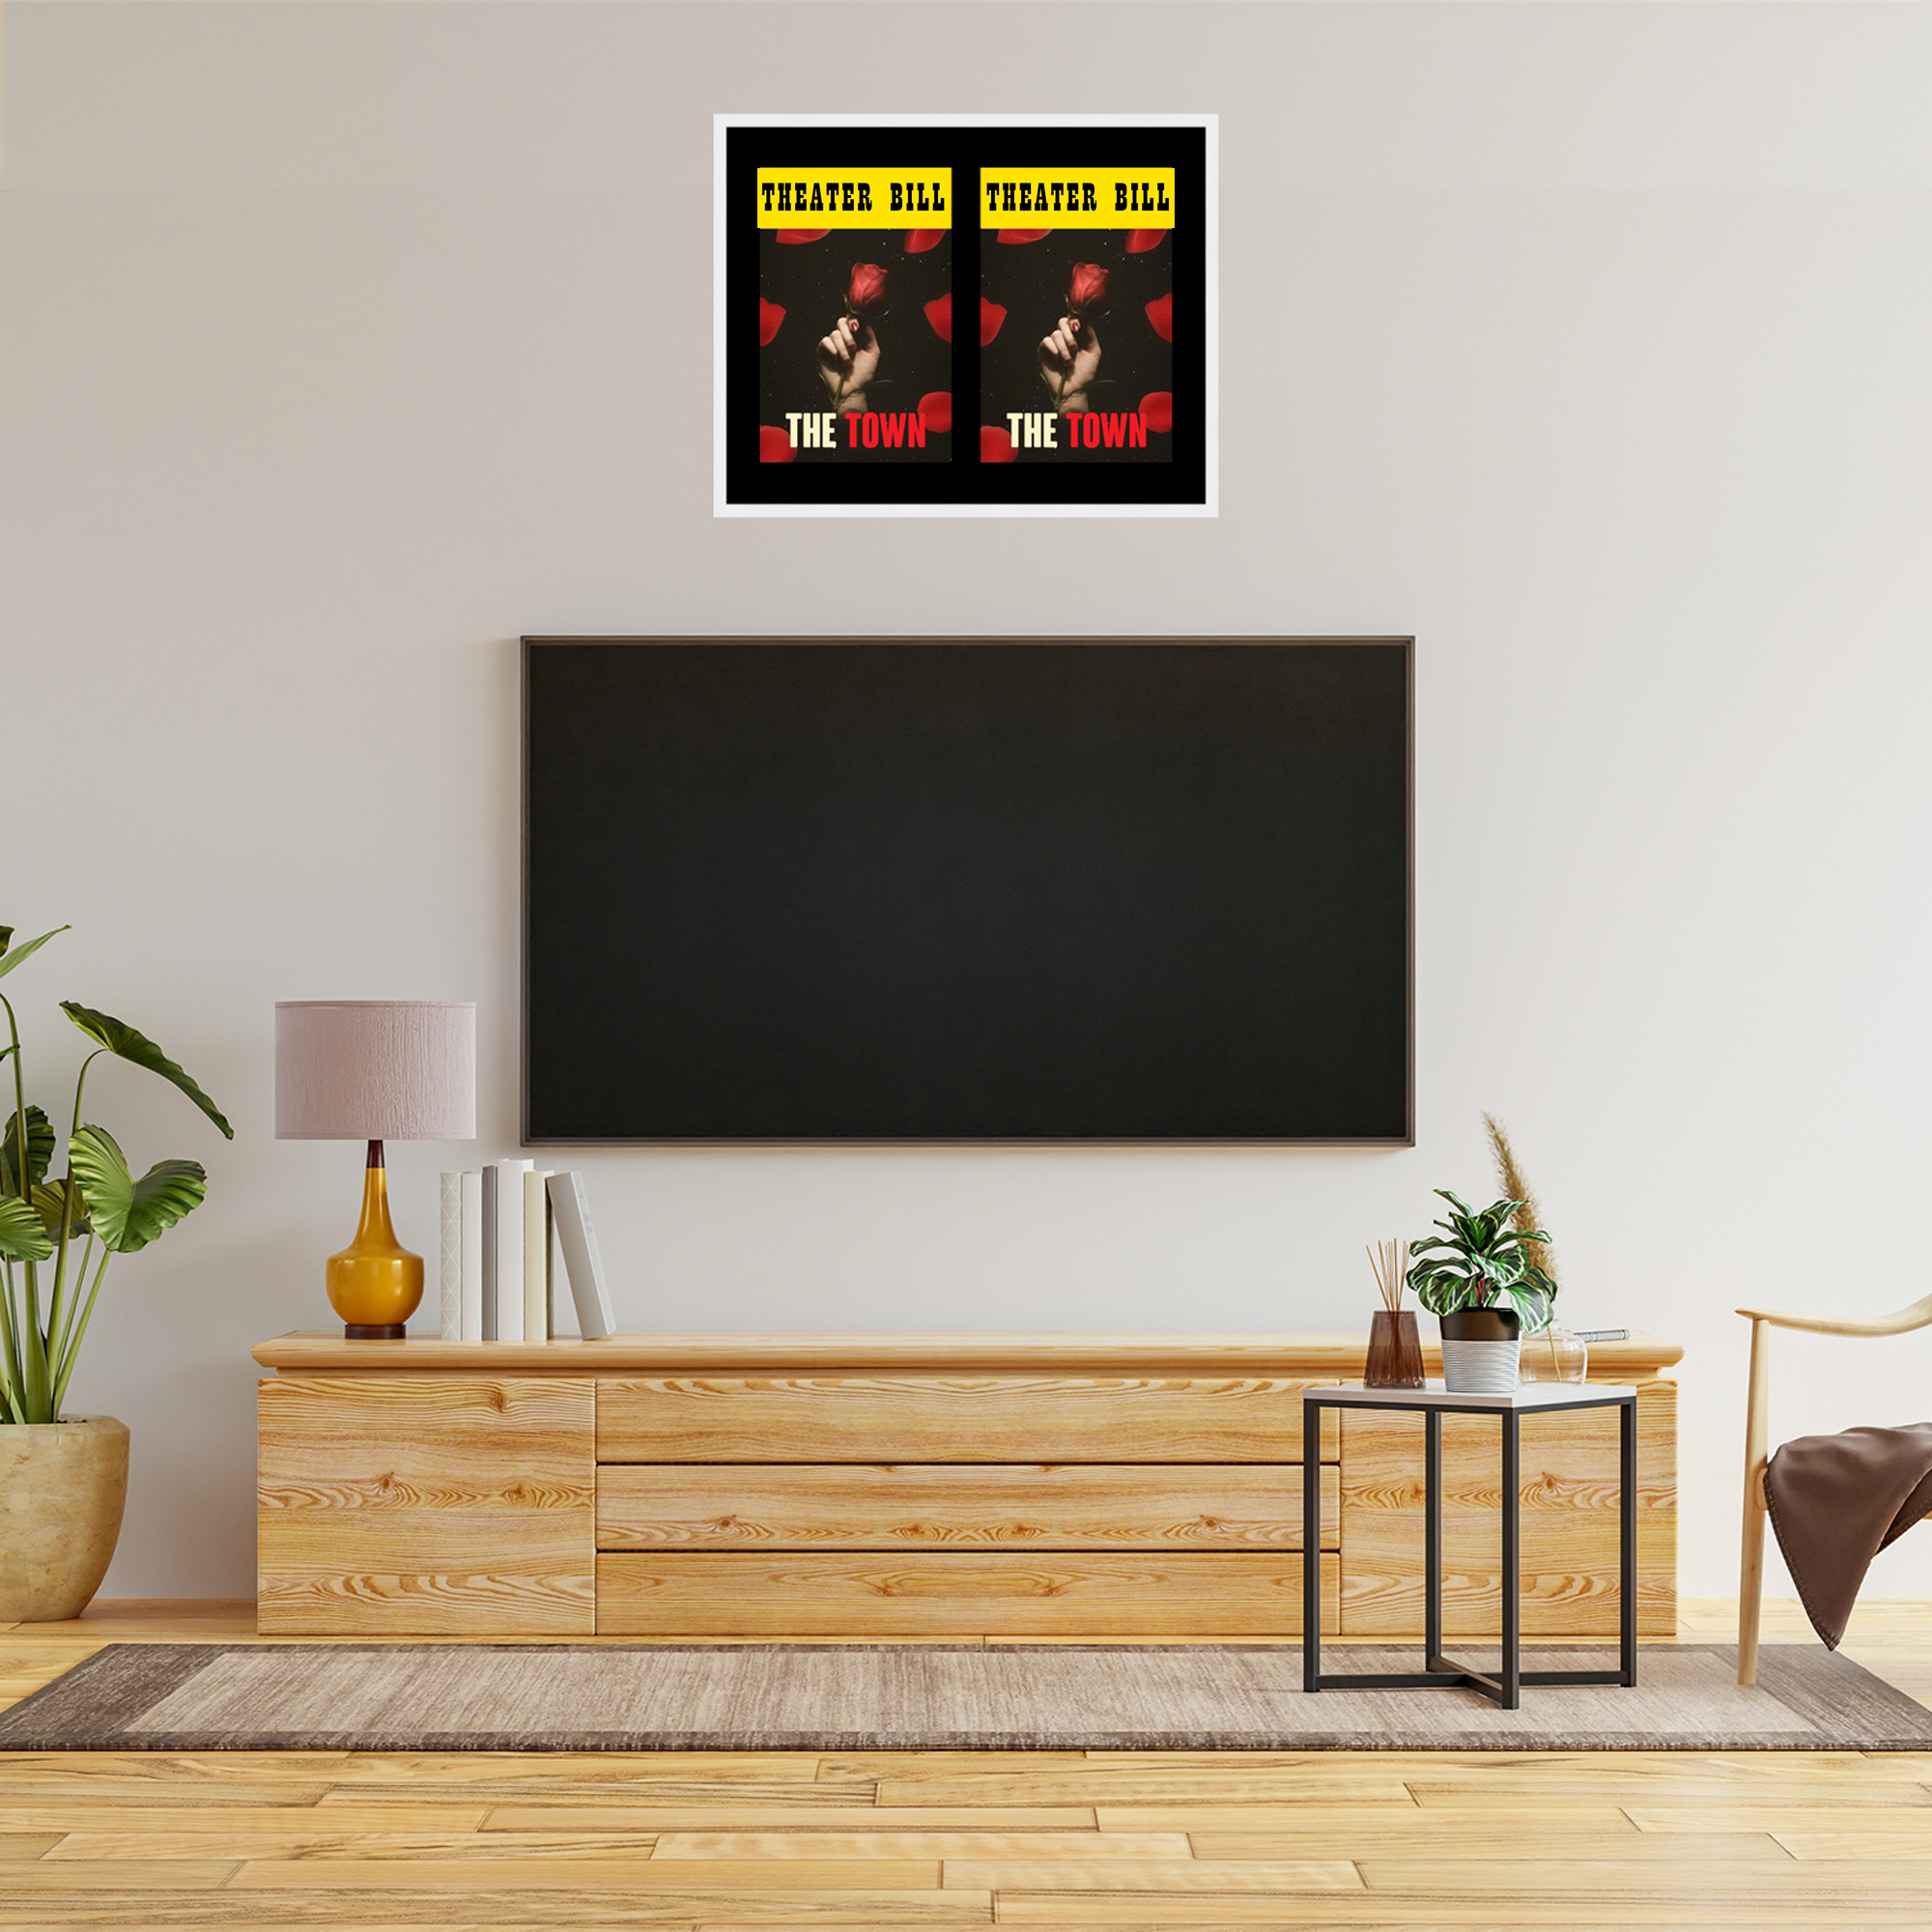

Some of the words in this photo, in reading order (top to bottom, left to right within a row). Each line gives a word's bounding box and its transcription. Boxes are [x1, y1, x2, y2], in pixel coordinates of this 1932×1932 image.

[761, 183, 873, 212] THEATER
[890, 183, 946, 212] BILL
[986, 183, 1097, 212] THEATER
[1114, 183, 1170, 212] BILL
[785, 412, 837, 448] THE
[845, 412, 926, 448] TOWN
[1007, 412, 1058, 448] THE
[1065, 412, 1148, 448] TOWN
